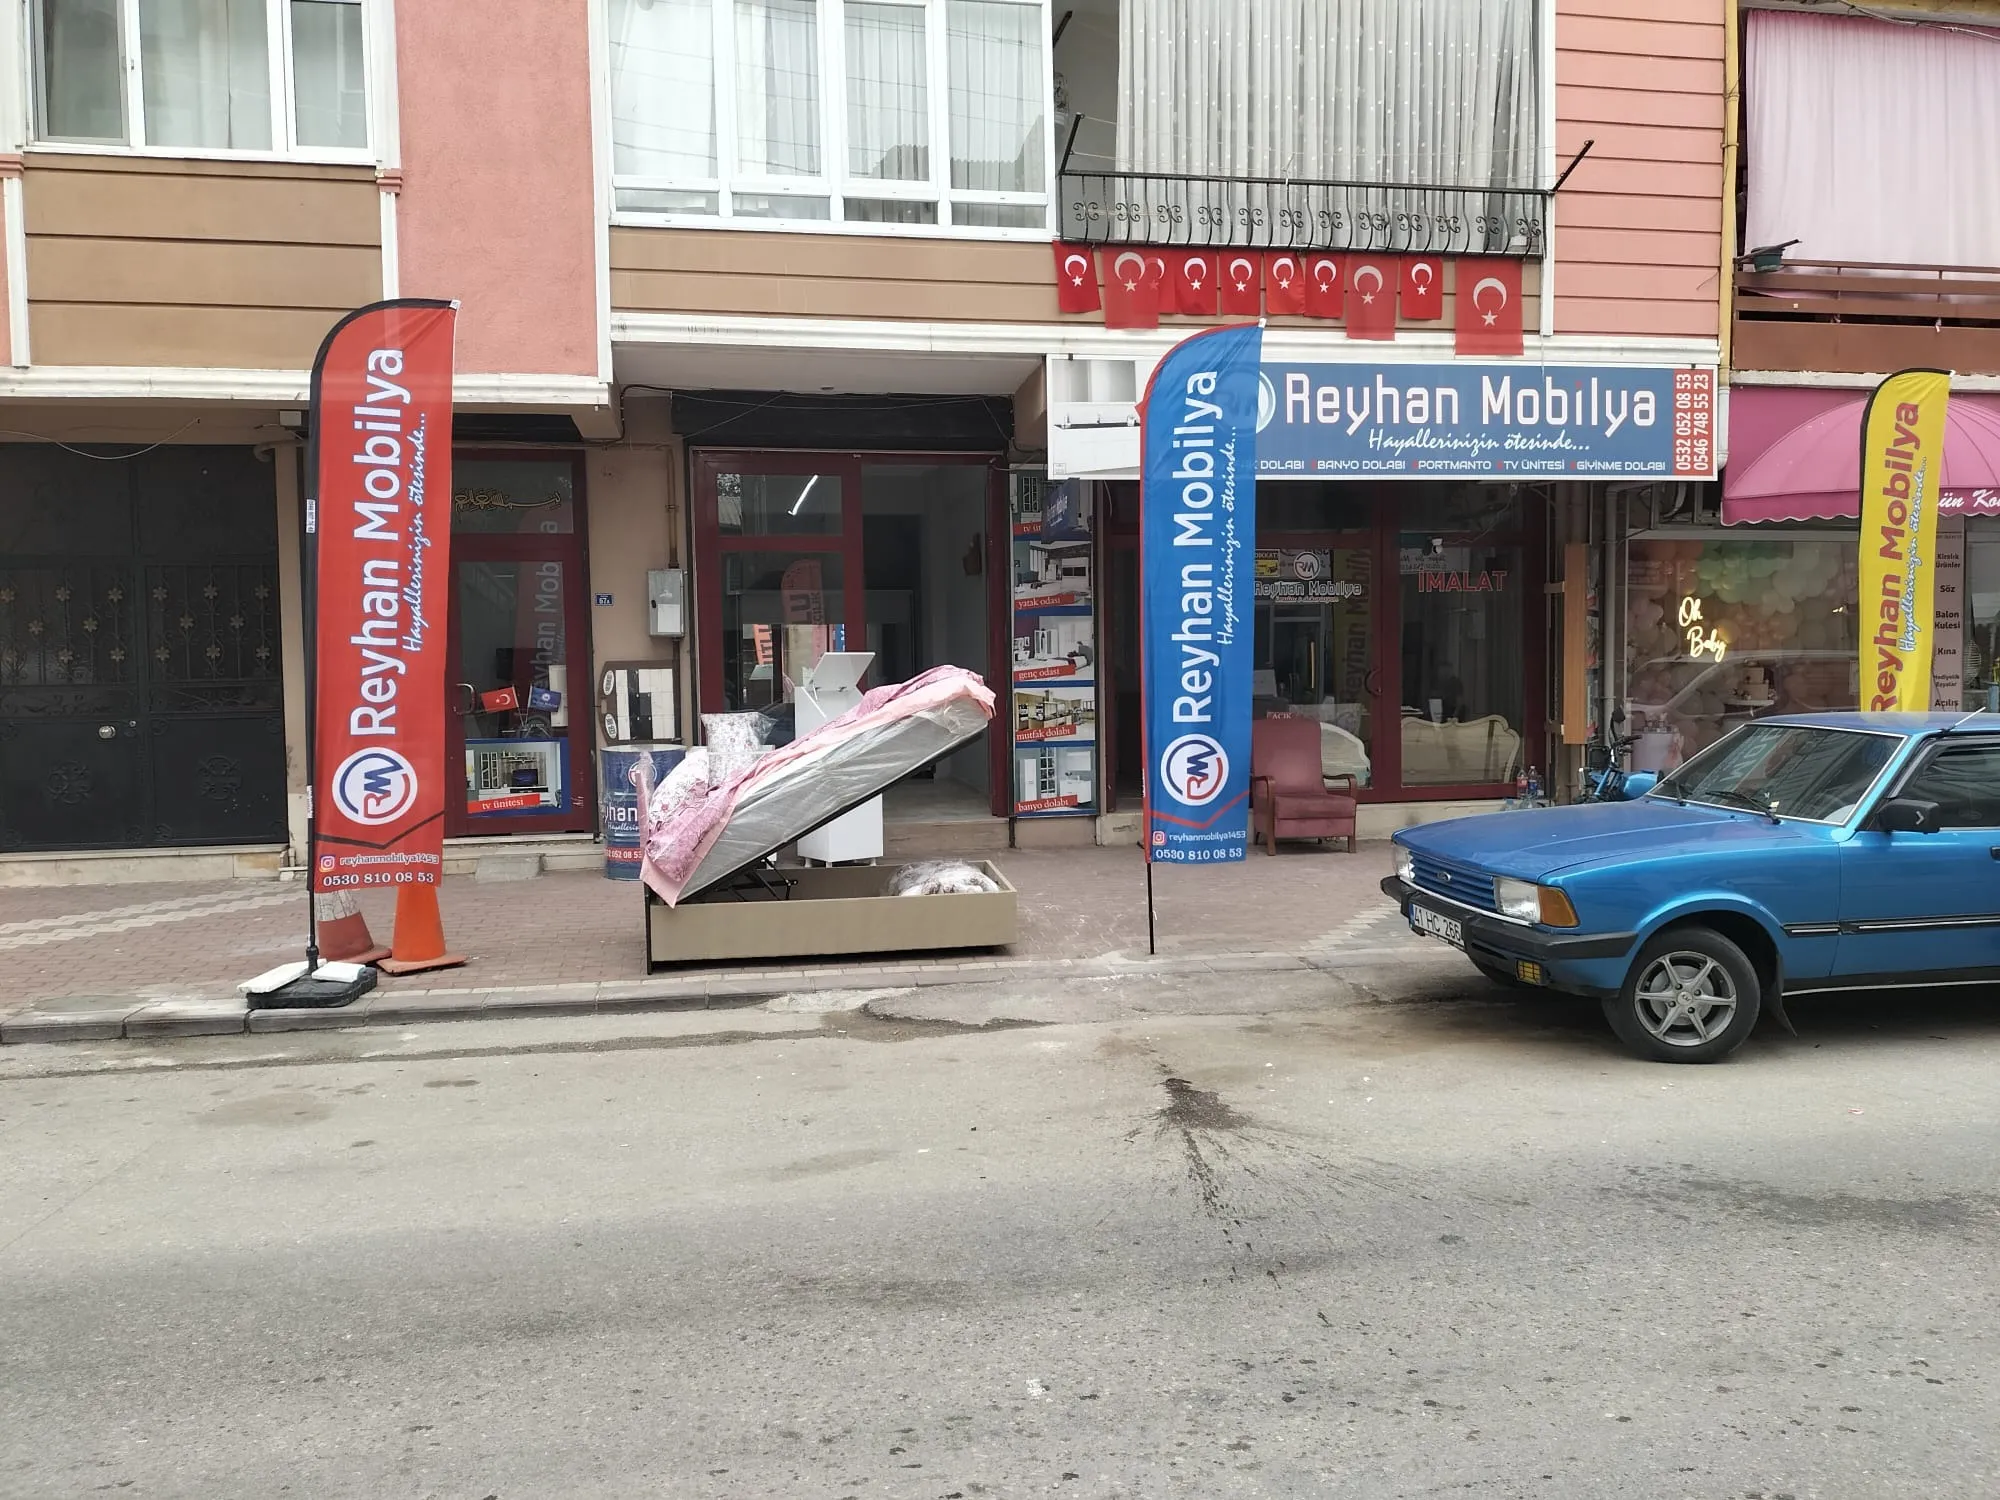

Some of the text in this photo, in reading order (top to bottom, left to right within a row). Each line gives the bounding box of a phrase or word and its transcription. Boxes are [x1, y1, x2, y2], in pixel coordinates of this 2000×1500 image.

[1285, 372, 1459, 436] Reyhan
[1482, 375, 1656, 438] Mobilya
[1676, 373, 1691, 470] 0532 052 08 53
[1693, 374, 1709, 470] 0546 748 55 23
[1369, 428, 1499, 457] Hayallerinizin
[1260, 460, 1305, 470] DOLABI
[1317, 460, 1406, 470] BANYO DOLABI
[1418, 460, 1492, 470] PORTMANTO
[1503, 458, 1565, 470] TV ÜNİTESİ
[1624, 460, 1666, 471] DOLABI
[350, 349, 411, 736] Reyhan Mobilya
[1171, 370, 1223, 723] Reyhan Mobilya
[1871, 402, 1921, 712] Reyhan Mobilya
[402, 511, 431, 651] Hayallerinizin
[1217, 517, 1241, 645] Hayallerinizin
[1417, 565, 1508, 593] İMALAT
[1253, 580, 1363, 600] Reyhan Mobilya
[1898, 536, 1922, 653] Hayallerinizin
[1940, 584, 1956, 593] Söz
[1018, 599, 1039, 610] yatak
[1678, 596, 1704, 628] Oh
[1935, 609, 1960, 619] Balon
[1686, 625, 1727, 663] Baby
[1018, 670, 1037, 681] genç
[1016, 726, 1070, 741] mutfak dolabı
[482, 798, 524, 810] tv ünitesi
[1017, 799, 1069, 812] banyo dolabı
[1169, 831, 1246, 843] reyhanmobilya1453
[1155, 847, 1242, 861] 0530 810 08 53
[323, 871, 434, 887] 0530 810 08 53
[1414, 906, 1462, 942] 41 HC 266
